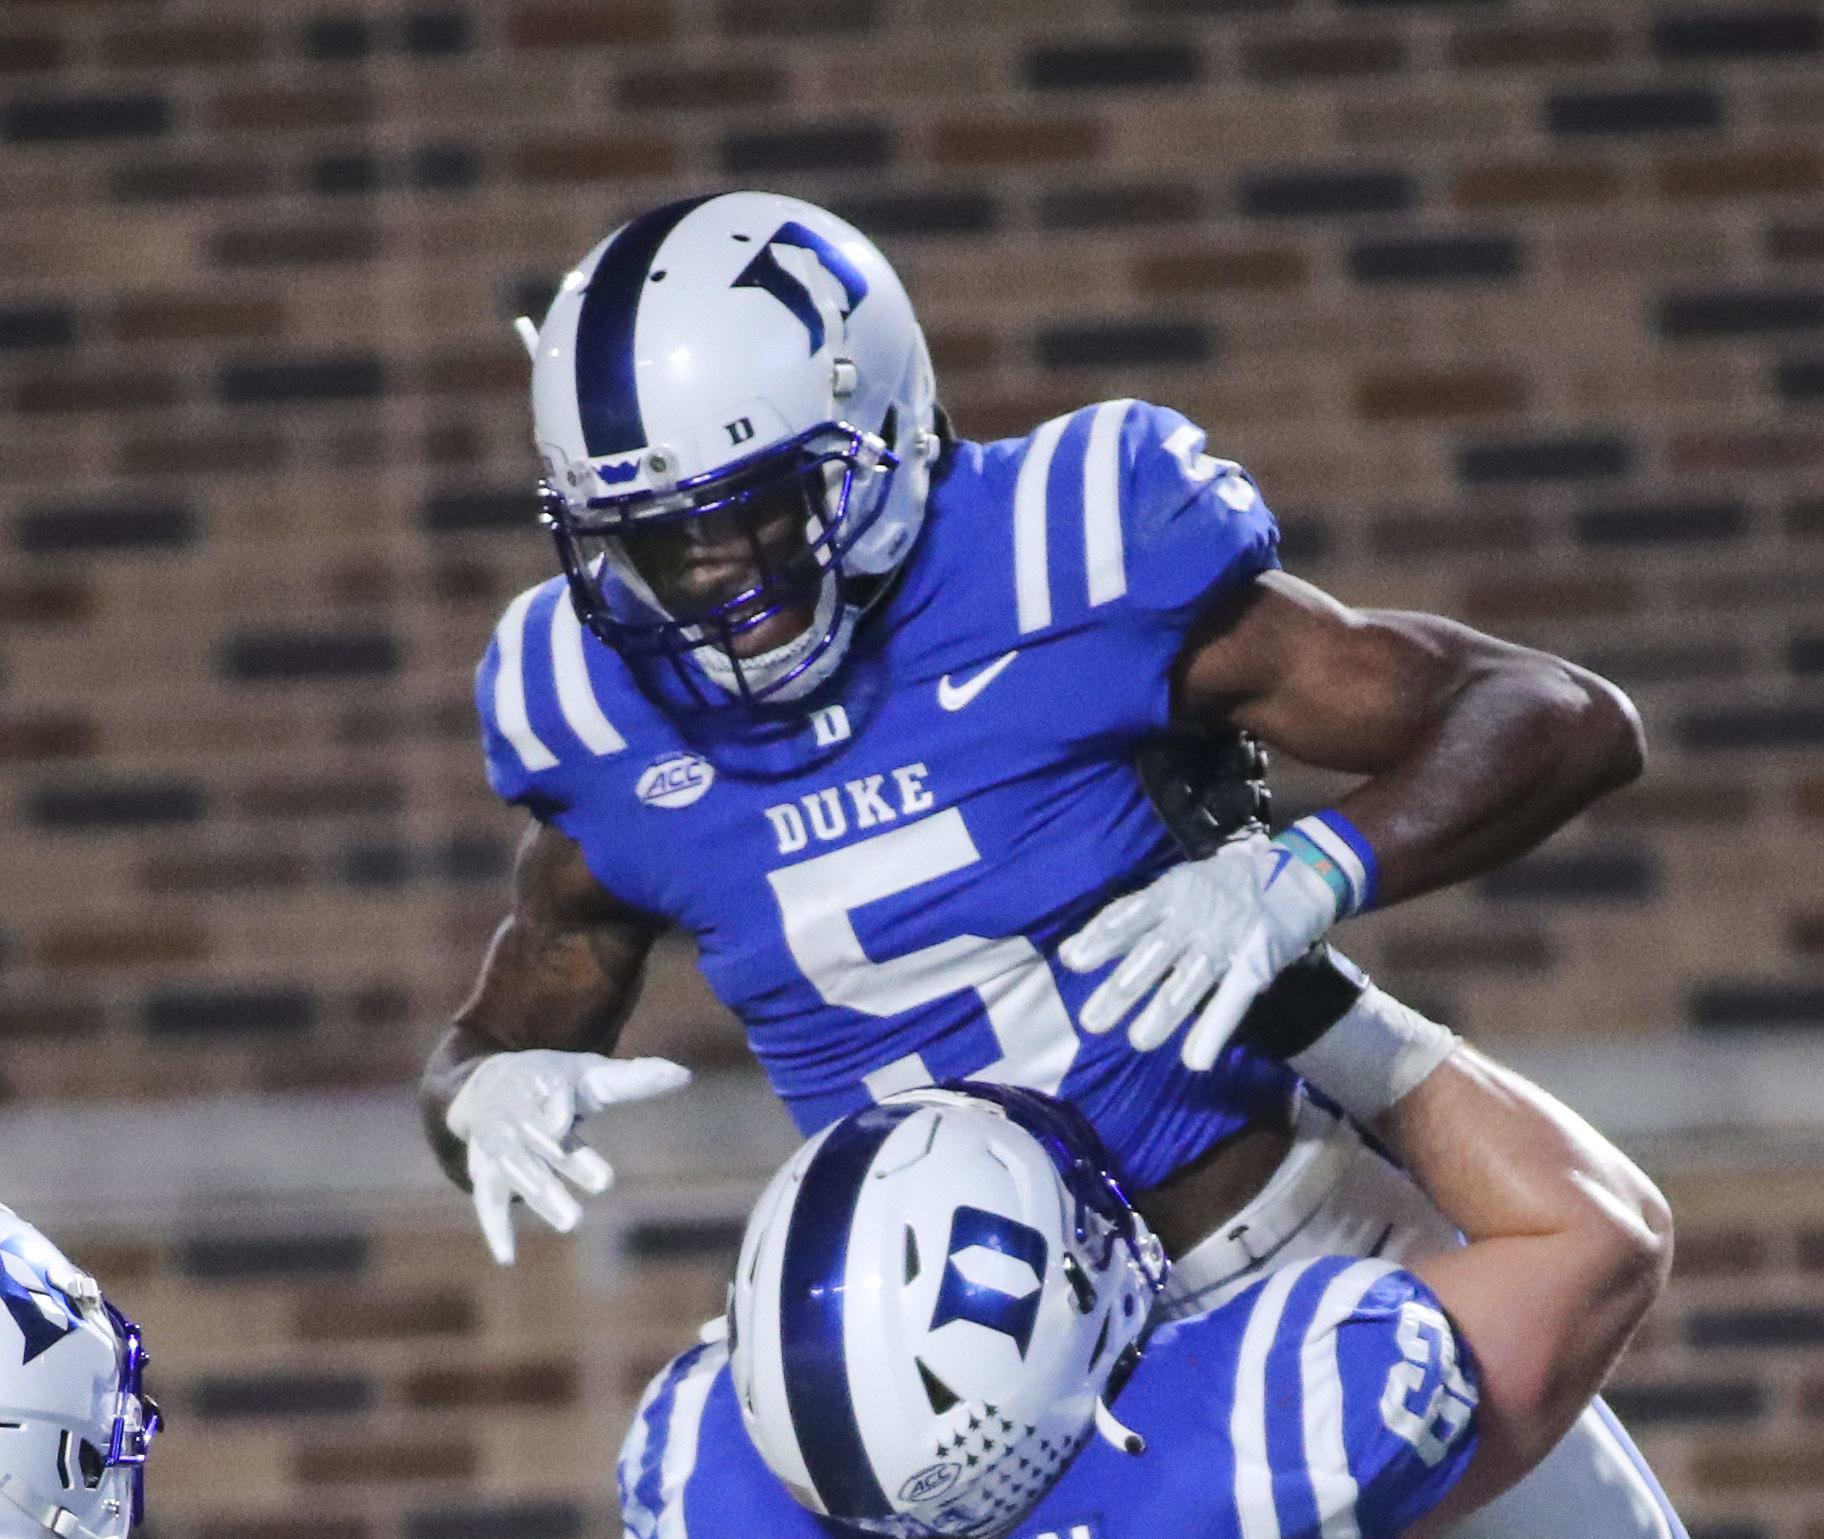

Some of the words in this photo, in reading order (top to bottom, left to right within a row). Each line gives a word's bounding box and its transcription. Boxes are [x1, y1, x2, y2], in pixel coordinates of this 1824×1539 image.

[724, 417, 754, 444] D
[809, 705, 851, 746] D
[647, 763, 703, 798] ACC
[764, 763, 933, 854] DUKE
[766, 806, 1080, 1105] 5
